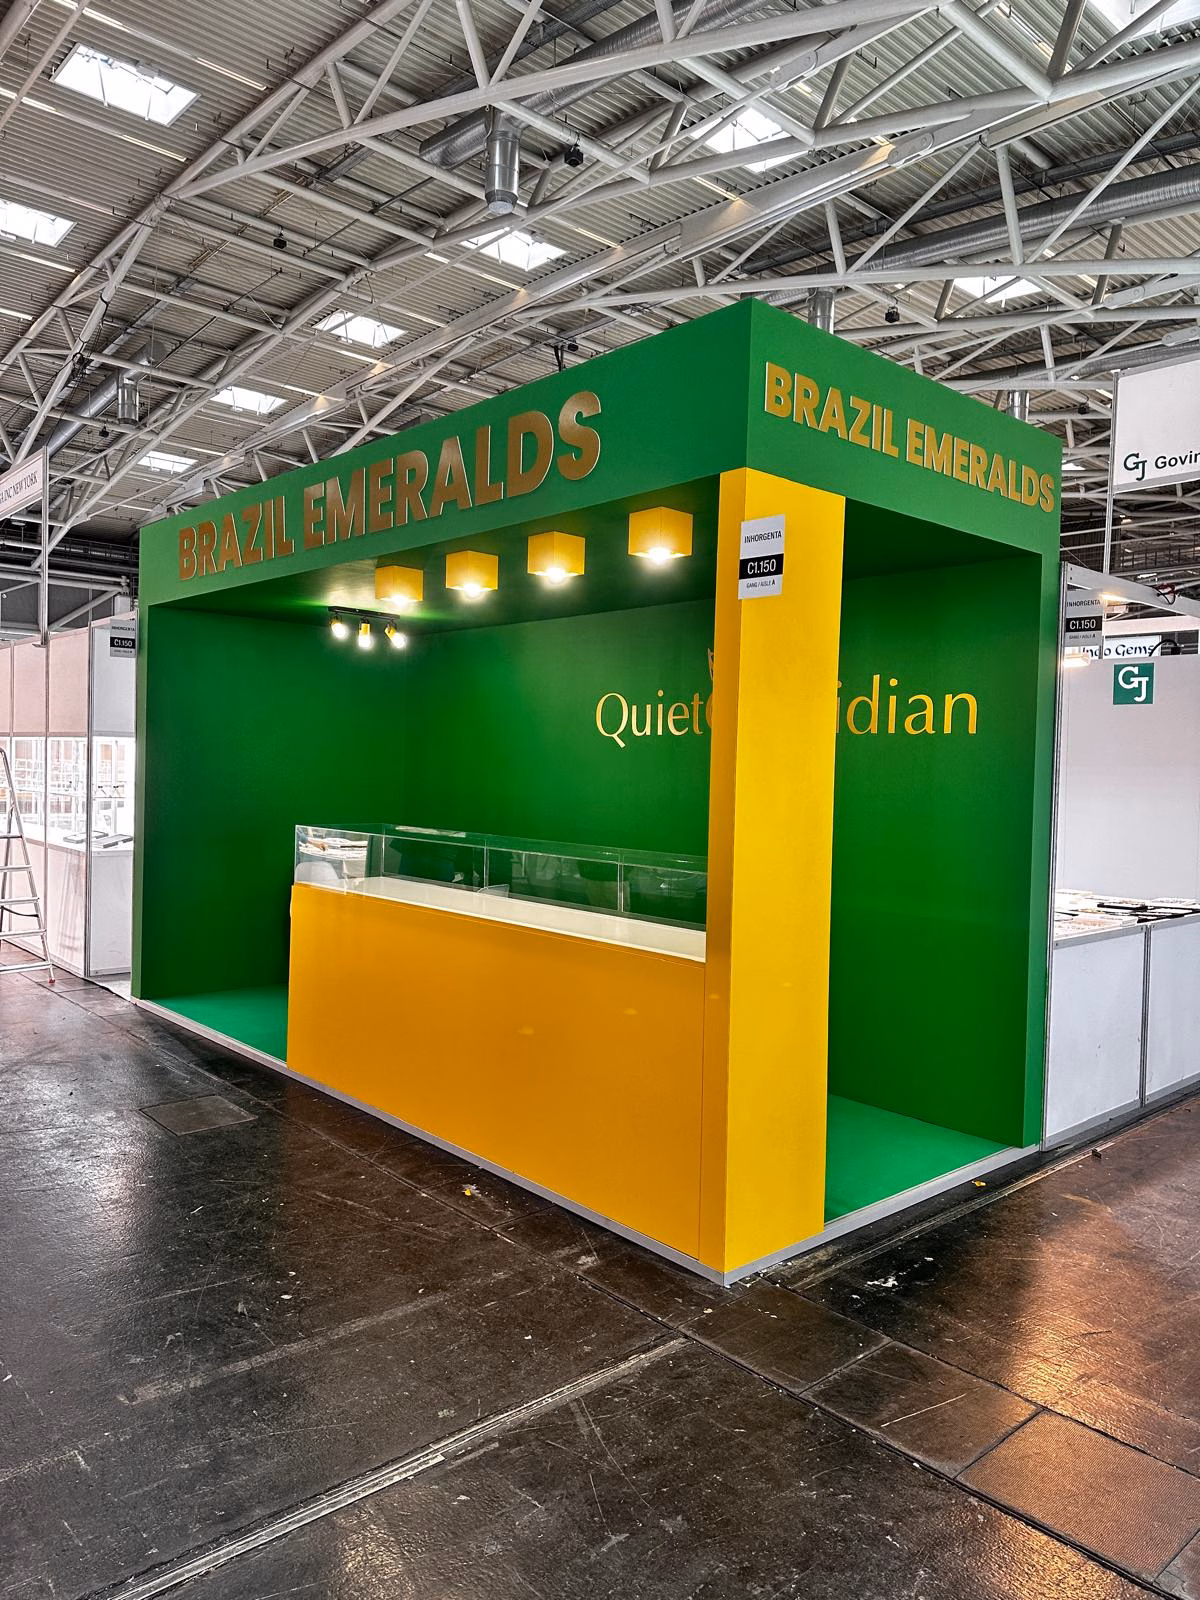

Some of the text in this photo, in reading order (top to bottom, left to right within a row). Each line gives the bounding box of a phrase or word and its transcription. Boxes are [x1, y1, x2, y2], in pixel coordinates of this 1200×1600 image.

[764, 361, 1055, 513] BRAZIL EMERALDS
[178, 391, 602, 581] BRAZIL EMERALDS
[744, 530, 782, 543] INHORGENTA
[747, 558, 777, 575] C1.150
[1066, 599, 1101, 607] INHORGENTA
[1069, 619, 1097, 630] C1.150
[113, 638, 133, 647] C1.150
[595, 689, 714, 748] Quiet
